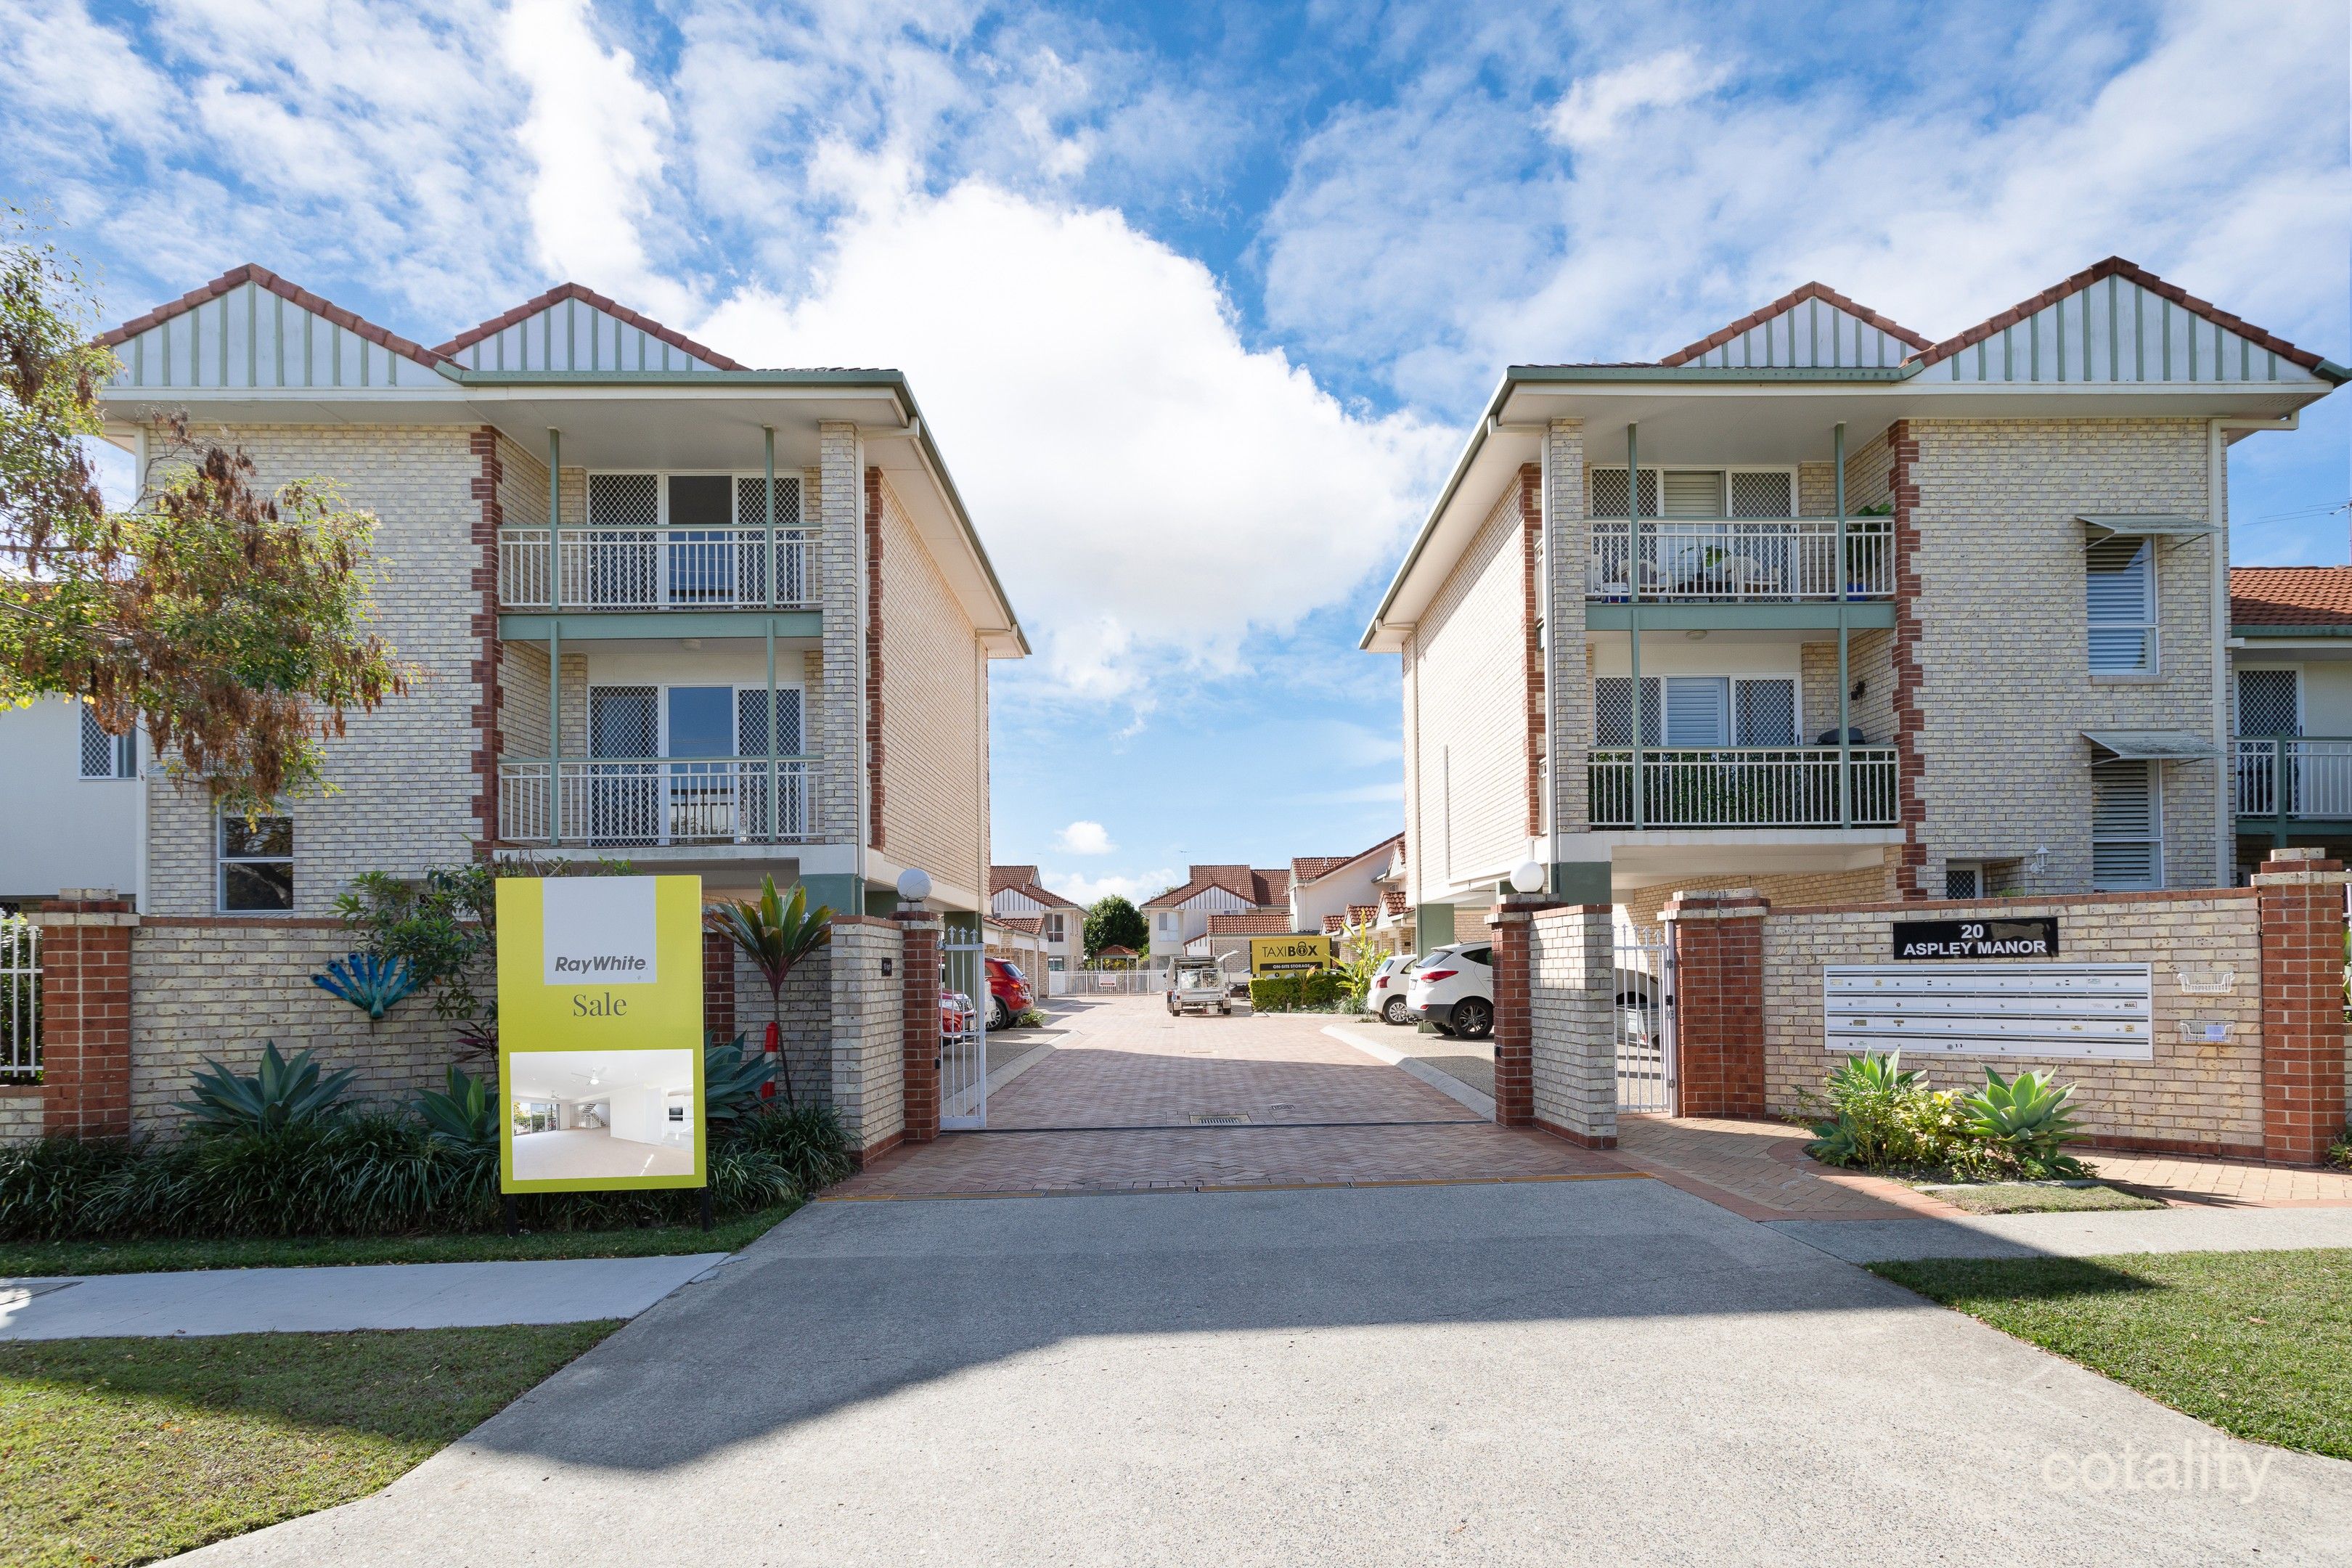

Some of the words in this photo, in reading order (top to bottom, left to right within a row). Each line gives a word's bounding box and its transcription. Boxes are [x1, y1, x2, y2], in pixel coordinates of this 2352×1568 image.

[1961, 923, 1984, 939] 20
[1903, 942, 1973, 956] ASPLEY
[1977, 940, 2047, 955] MANOR
[573, 992, 627, 1017] Sale
